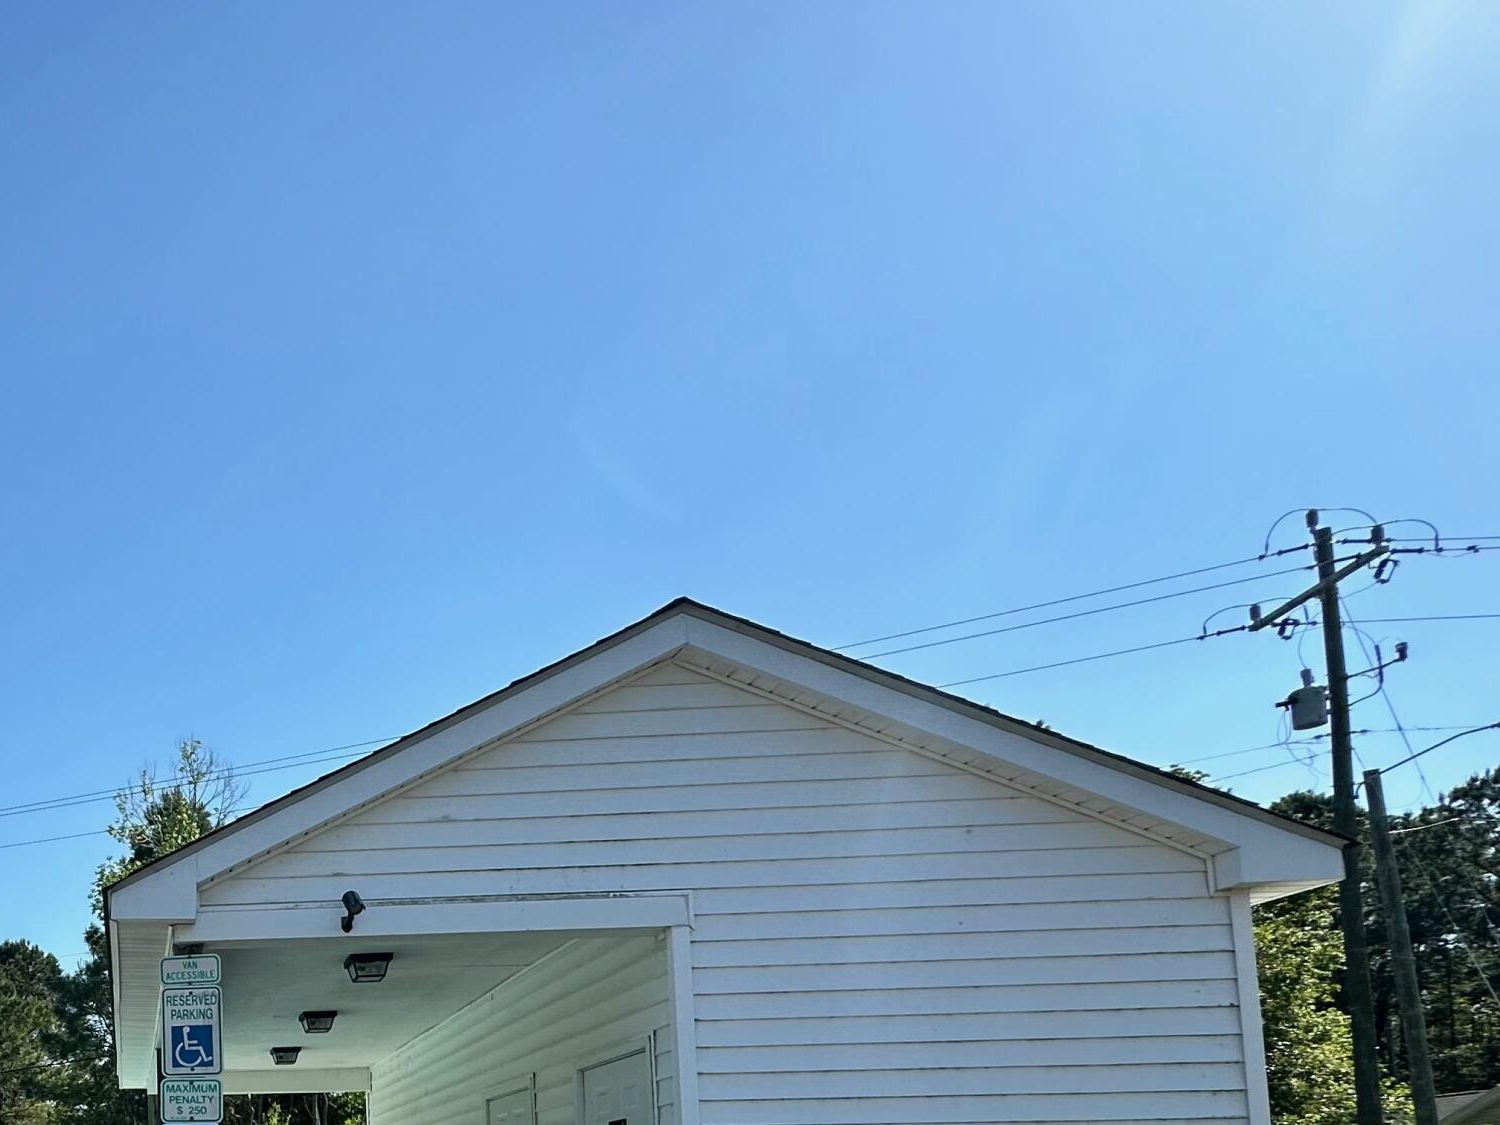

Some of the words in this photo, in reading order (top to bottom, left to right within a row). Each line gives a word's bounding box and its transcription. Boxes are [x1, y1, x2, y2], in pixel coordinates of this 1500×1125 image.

[182, 960, 198, 969] VAN
[165, 970, 216, 981] ACCESSIBLE
[165, 994, 218, 1007] RESERVED
[170, 1008, 213, 1020] PARKING
[165, 1084, 218, 1093] MAXIMUM
[169, 1095, 214, 1104] PENALTY
[188, 1105, 207, 1115] 250
